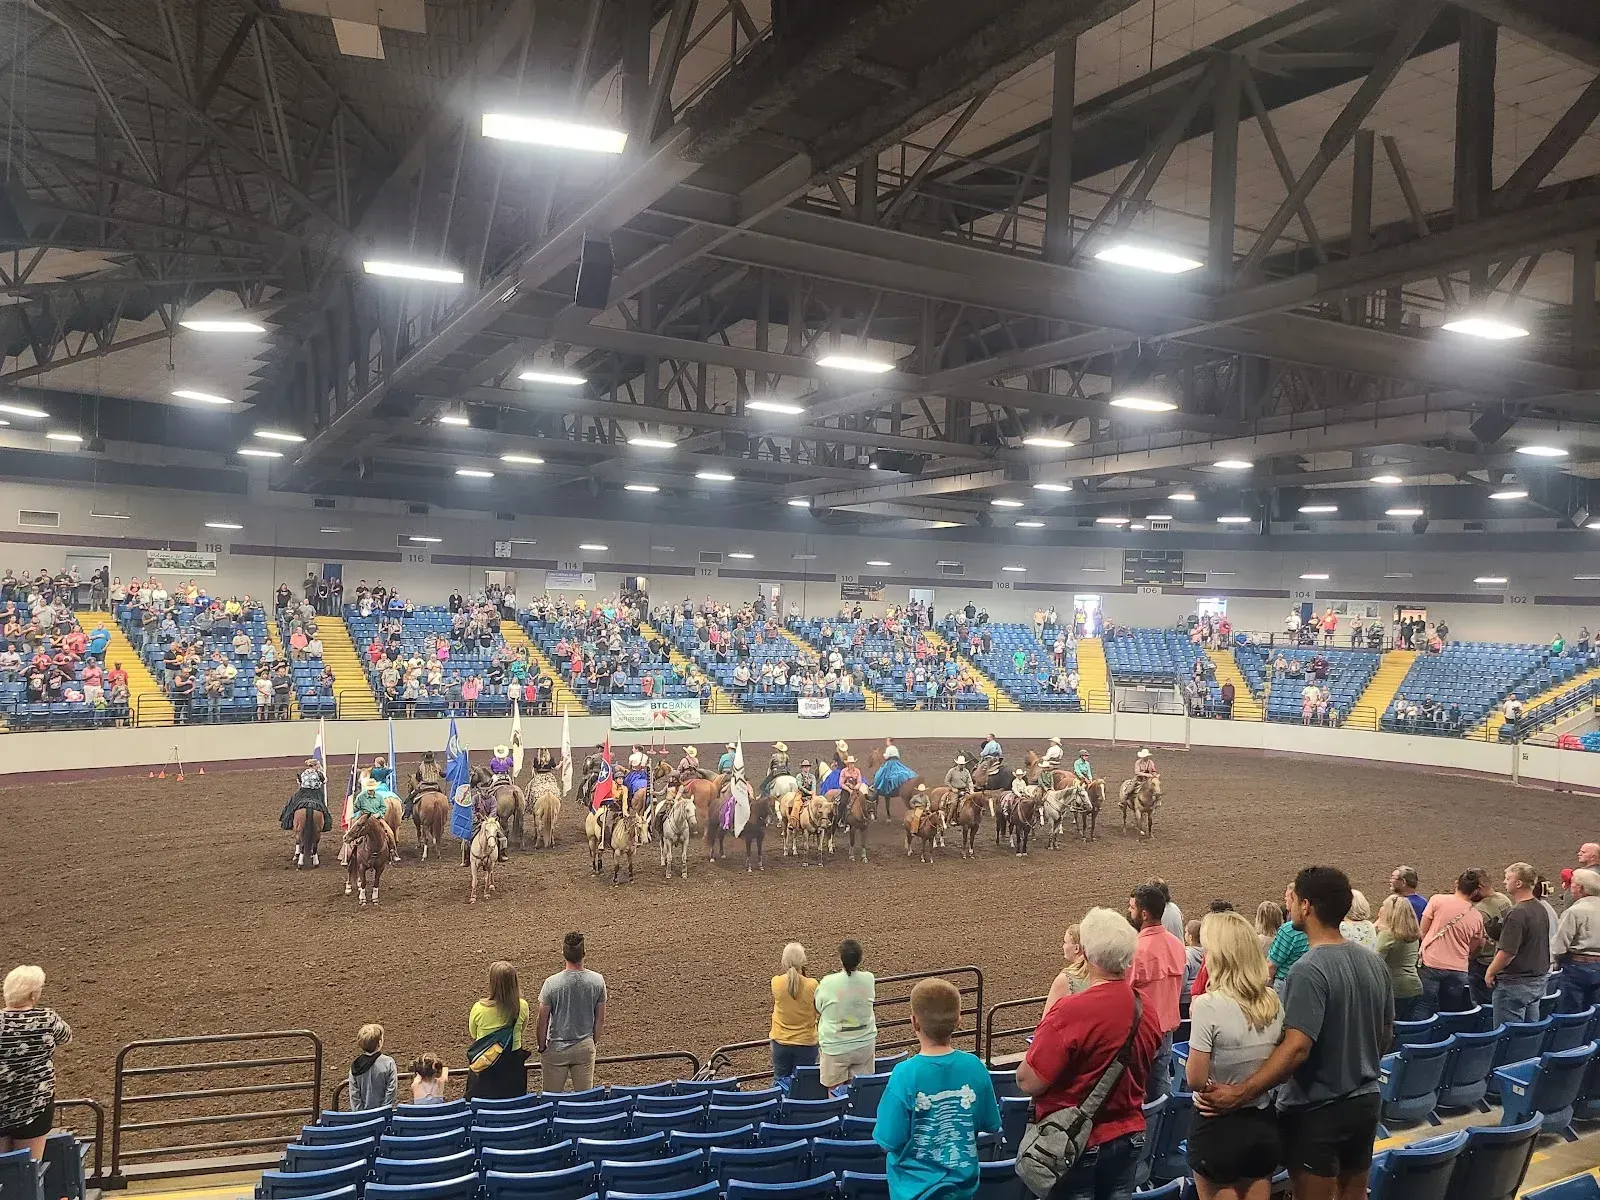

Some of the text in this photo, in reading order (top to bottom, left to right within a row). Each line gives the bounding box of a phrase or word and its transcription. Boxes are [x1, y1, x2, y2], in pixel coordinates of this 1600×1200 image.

[205, 544, 222, 552] 118
[409, 554, 424, 562] 116
[564, 562, 577, 570] 114
[701, 568, 712, 576] 112
[1509, 596, 1527, 604] 102
